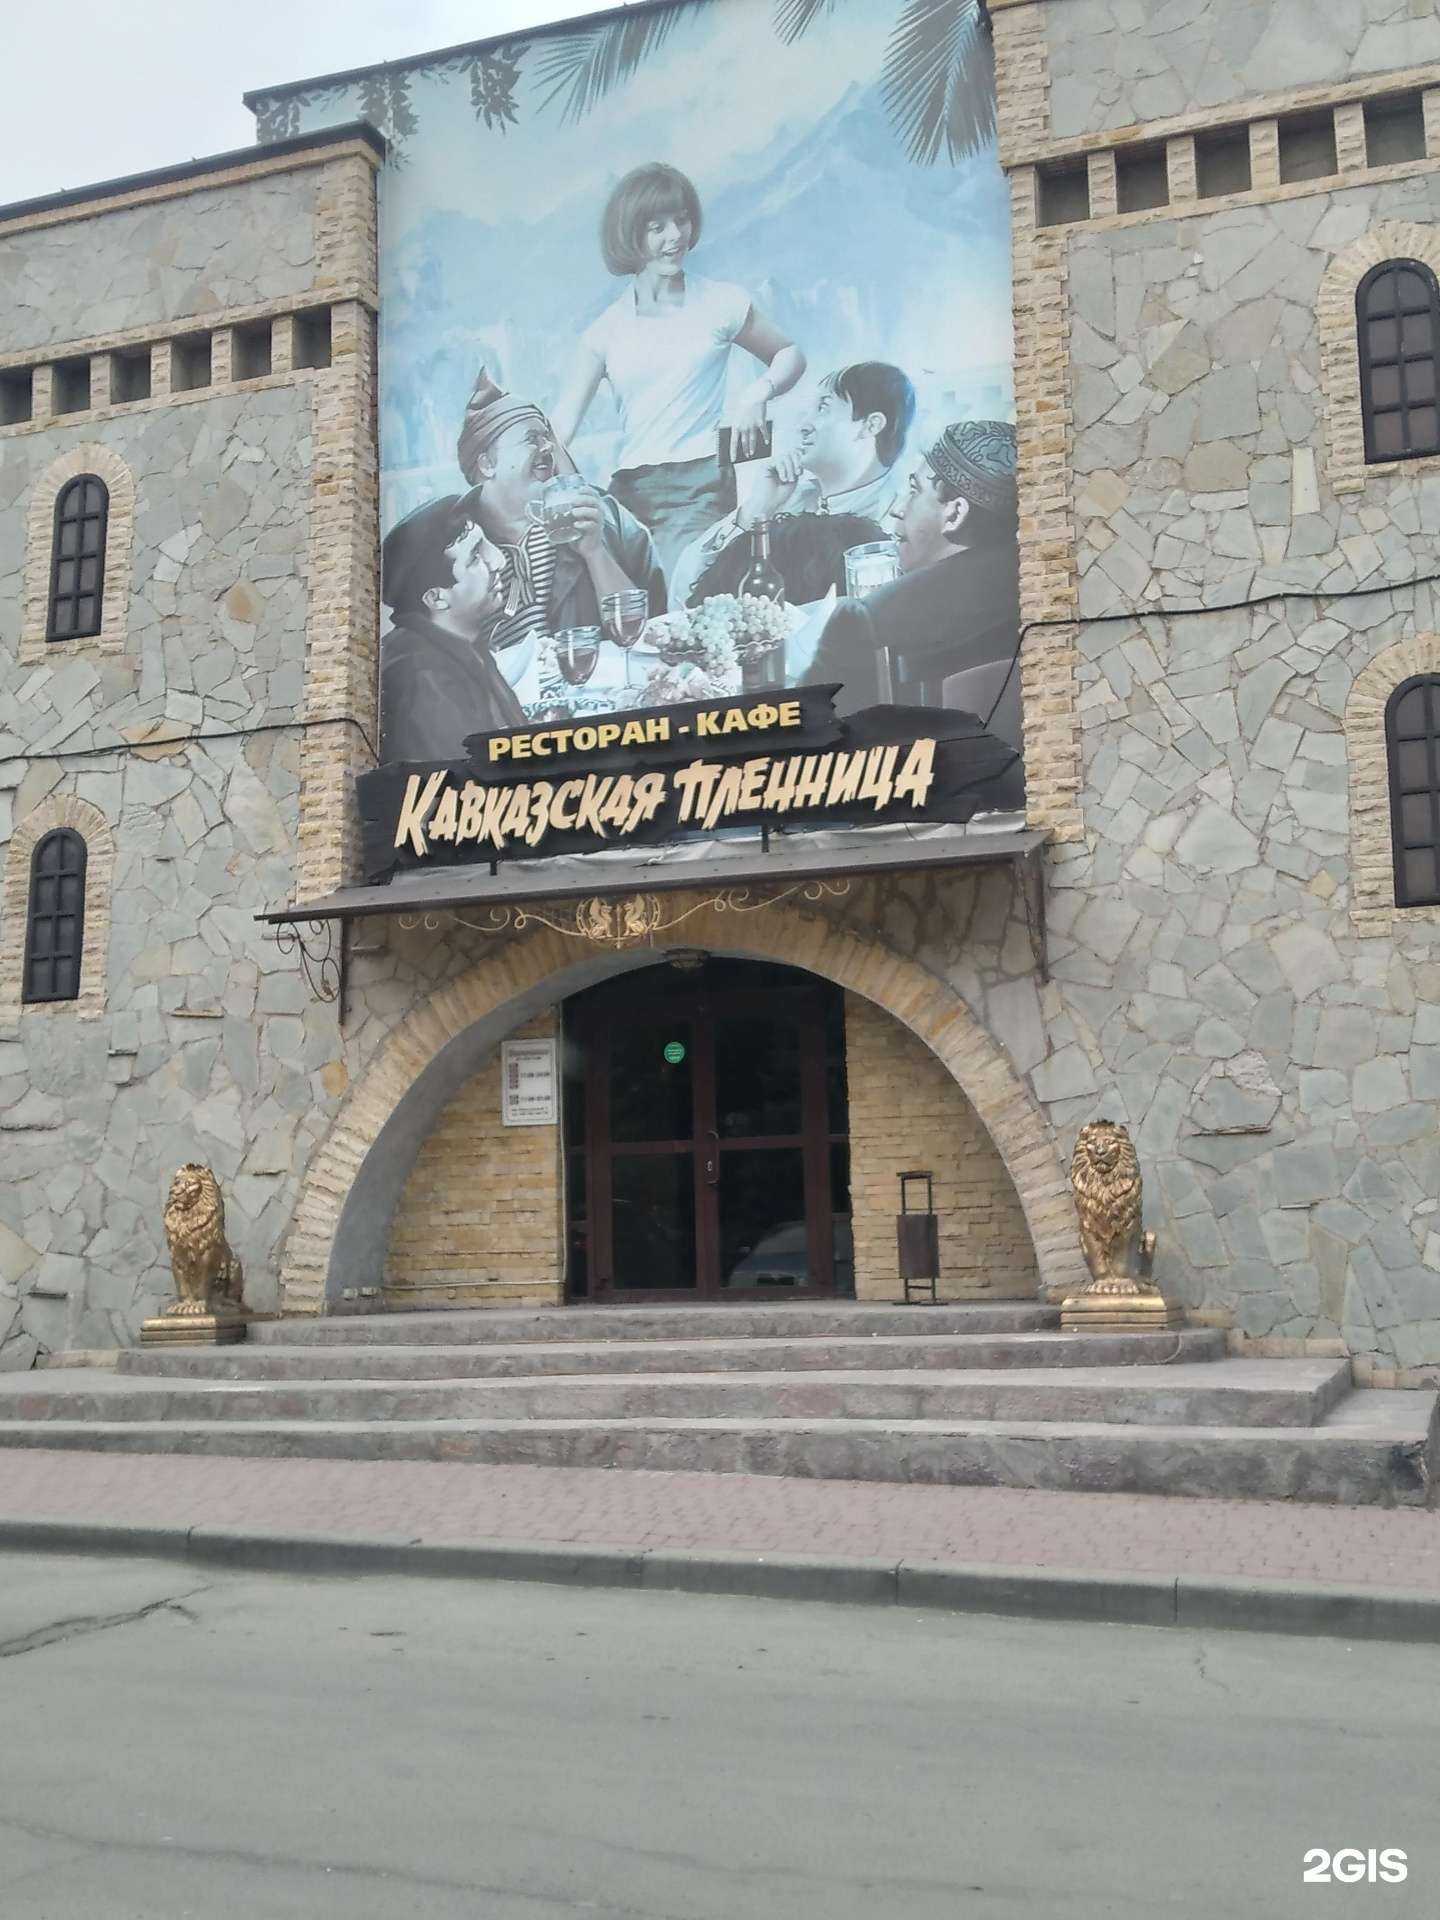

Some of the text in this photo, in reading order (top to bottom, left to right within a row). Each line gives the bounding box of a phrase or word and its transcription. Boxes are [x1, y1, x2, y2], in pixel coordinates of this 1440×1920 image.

[488, 716, 670, 762] РЕСТОРАН
[697, 701, 800, 736] КАФЕ
[673, 738, 936, 830] ПЛЕННИЦА
